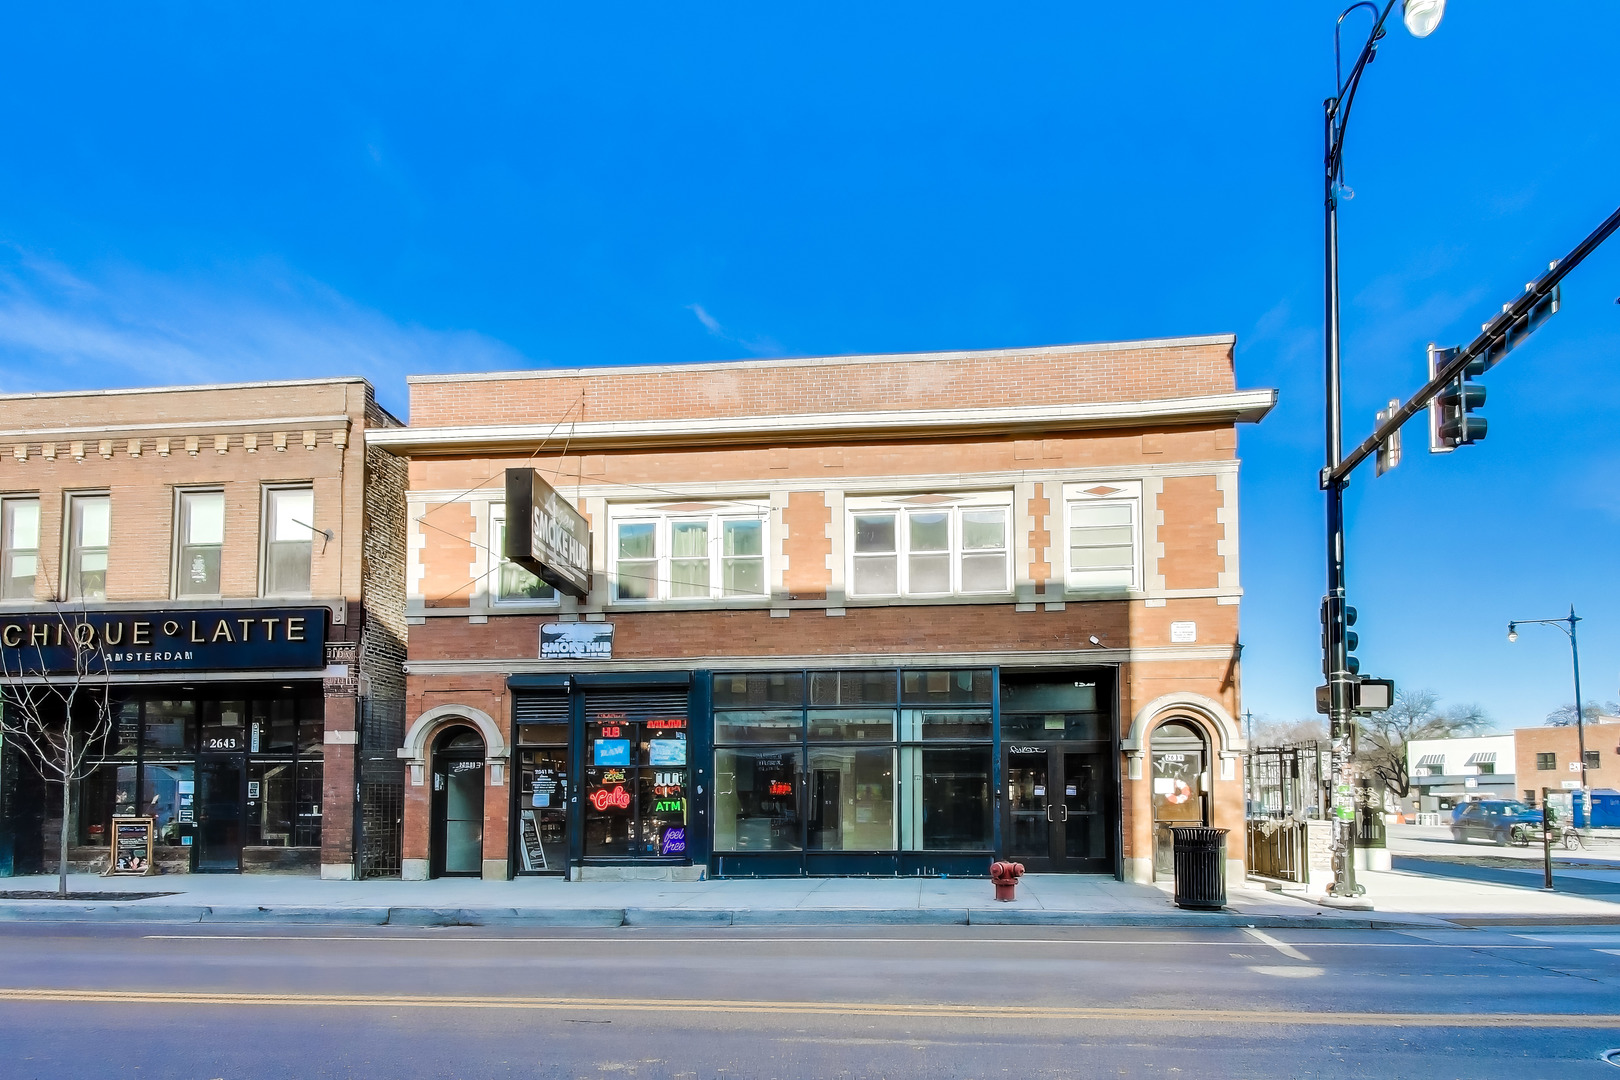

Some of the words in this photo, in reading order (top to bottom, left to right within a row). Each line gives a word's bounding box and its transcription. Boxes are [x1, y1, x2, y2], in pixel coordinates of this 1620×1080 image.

[533, 506, 569, 559] SMOKE
[569, 535, 587, 572] HUB
[3, 622, 150, 650] CHIQUE
[191, 618, 305, 643] LATTE
[105, 651, 193, 662] AMSTERDAM
[602, 726, 620, 737] HUB
[209, 738, 236, 749] 2643
[655, 801, 681, 812] ATM
[663, 828, 685, 843] feel
[663, 840, 686, 855] free
